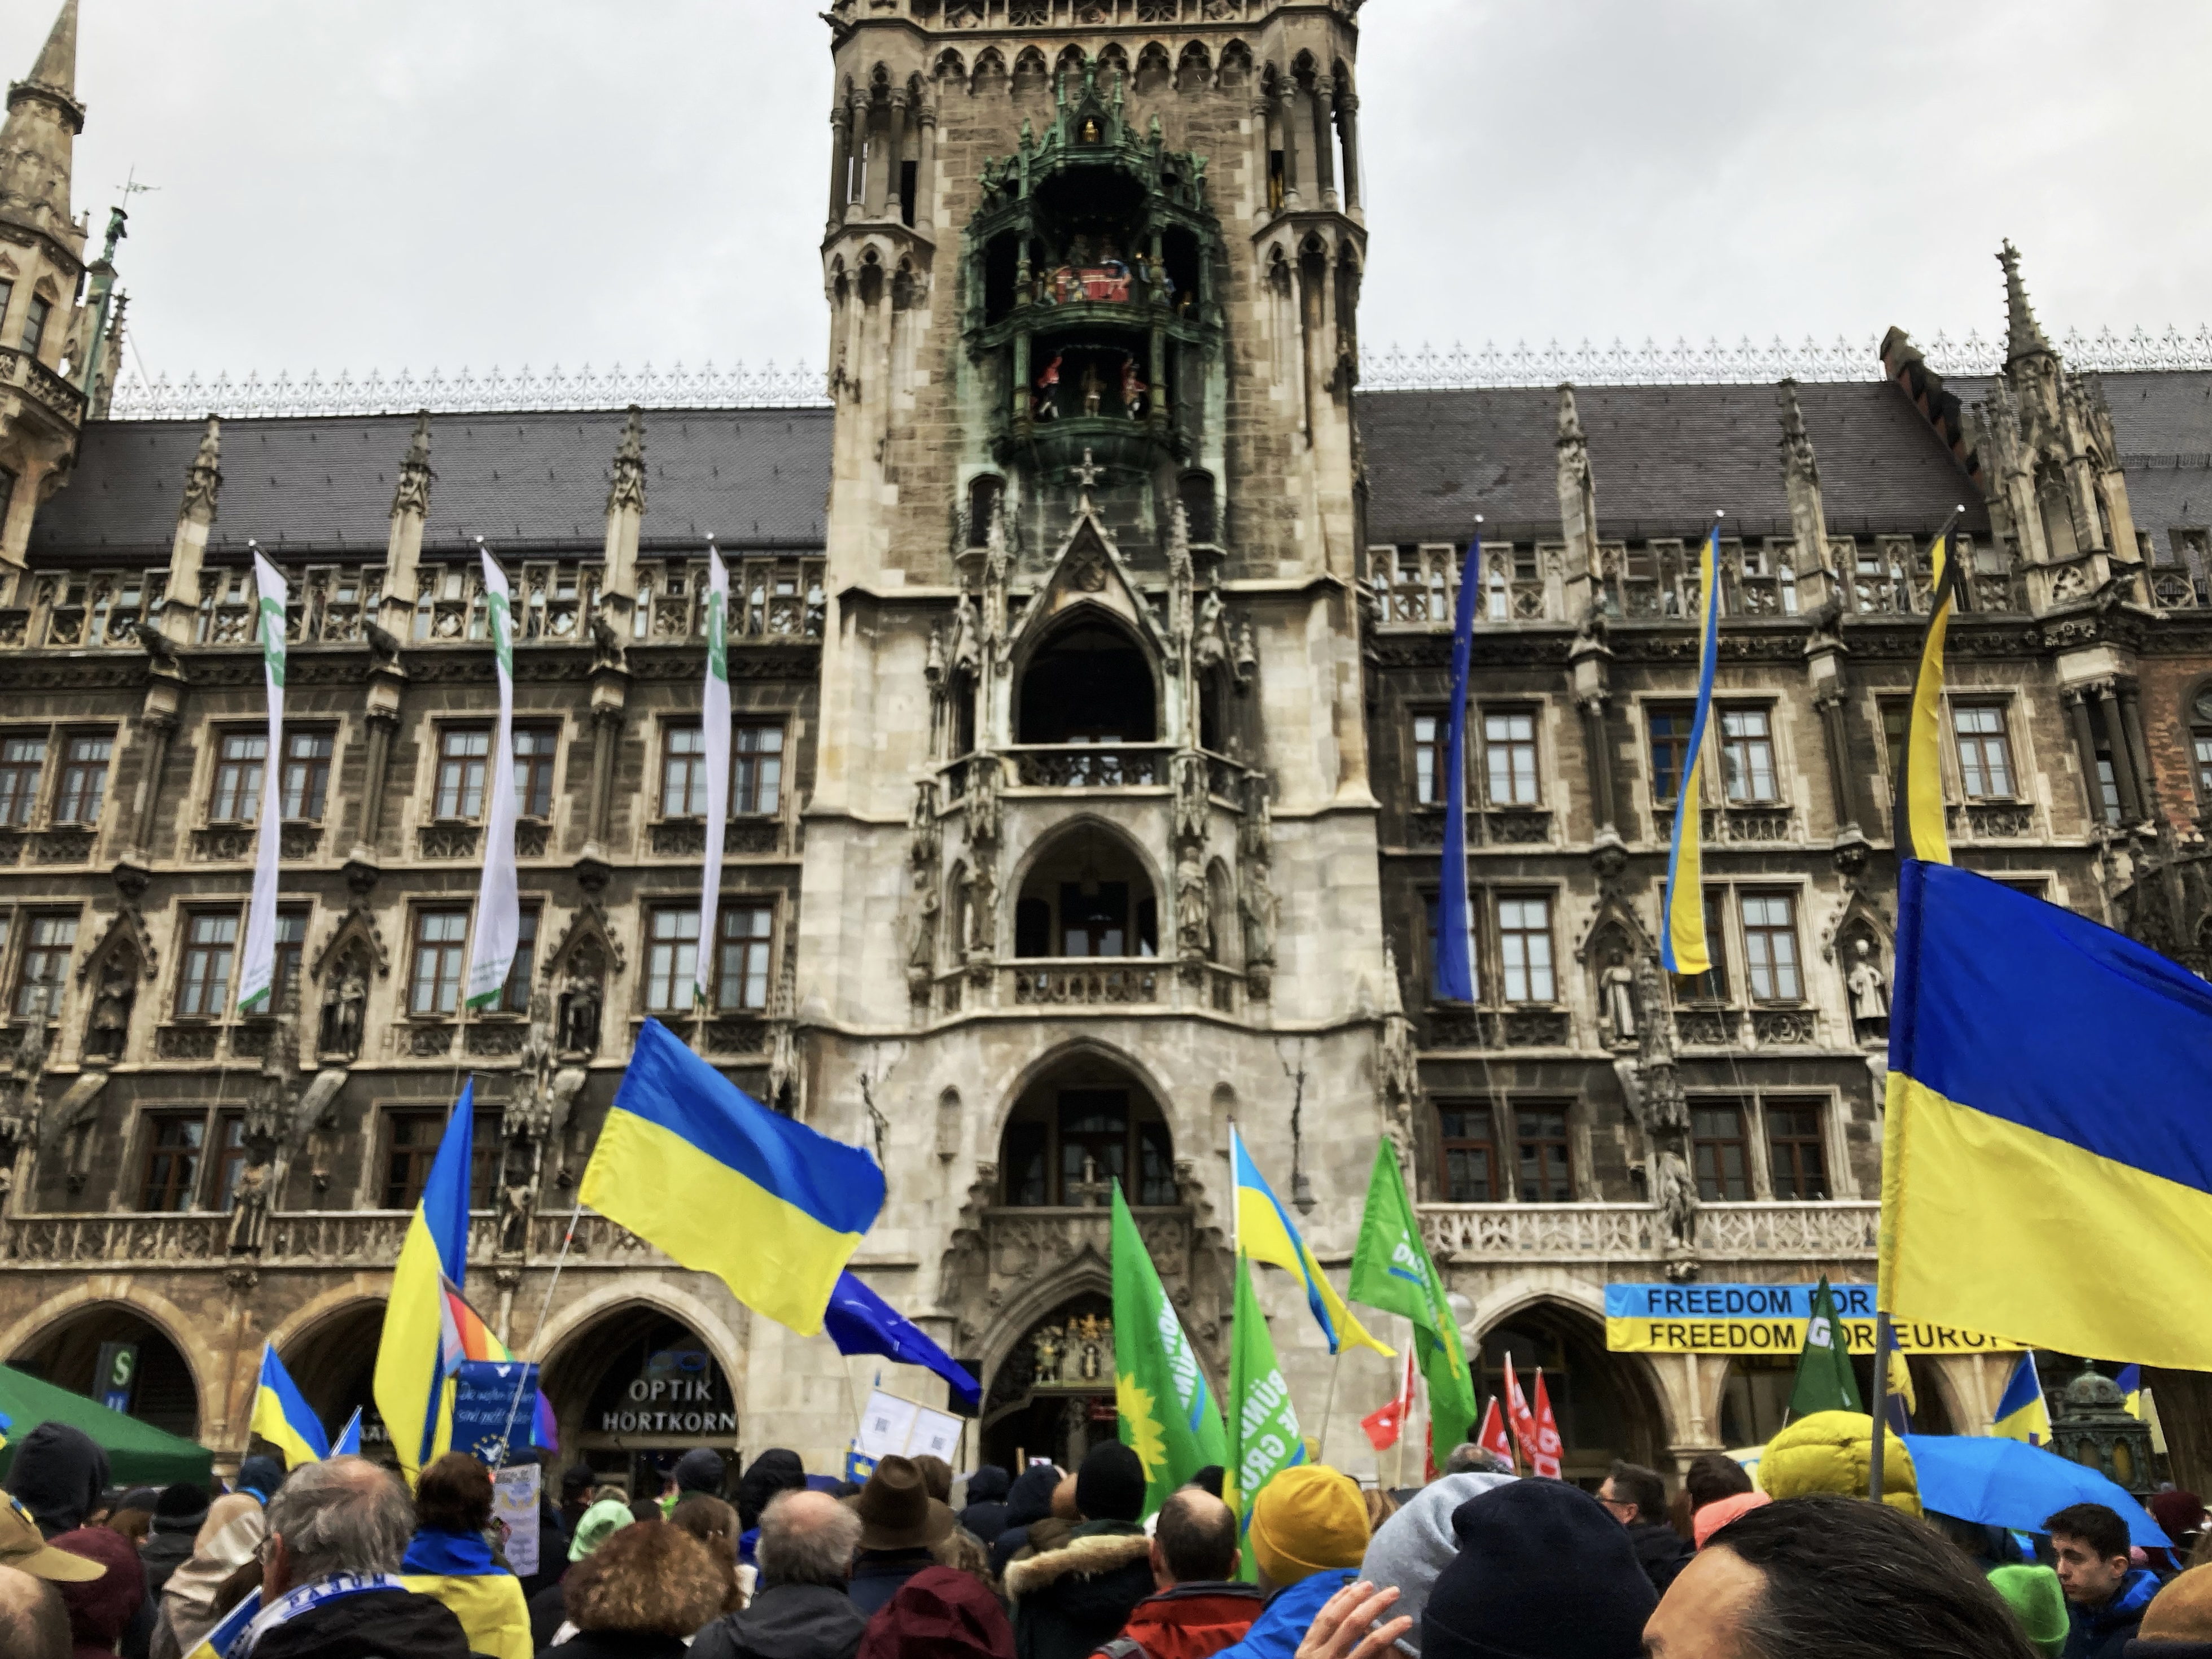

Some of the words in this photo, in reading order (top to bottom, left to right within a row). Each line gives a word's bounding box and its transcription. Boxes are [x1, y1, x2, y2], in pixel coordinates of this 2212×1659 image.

[1648, 1289, 1793, 1314] FREEDOM
[1650, 1324, 1797, 1349] FREEDOM
[113, 1350, 131, 1386] S
[629, 1378, 712, 1402] OPTIK
